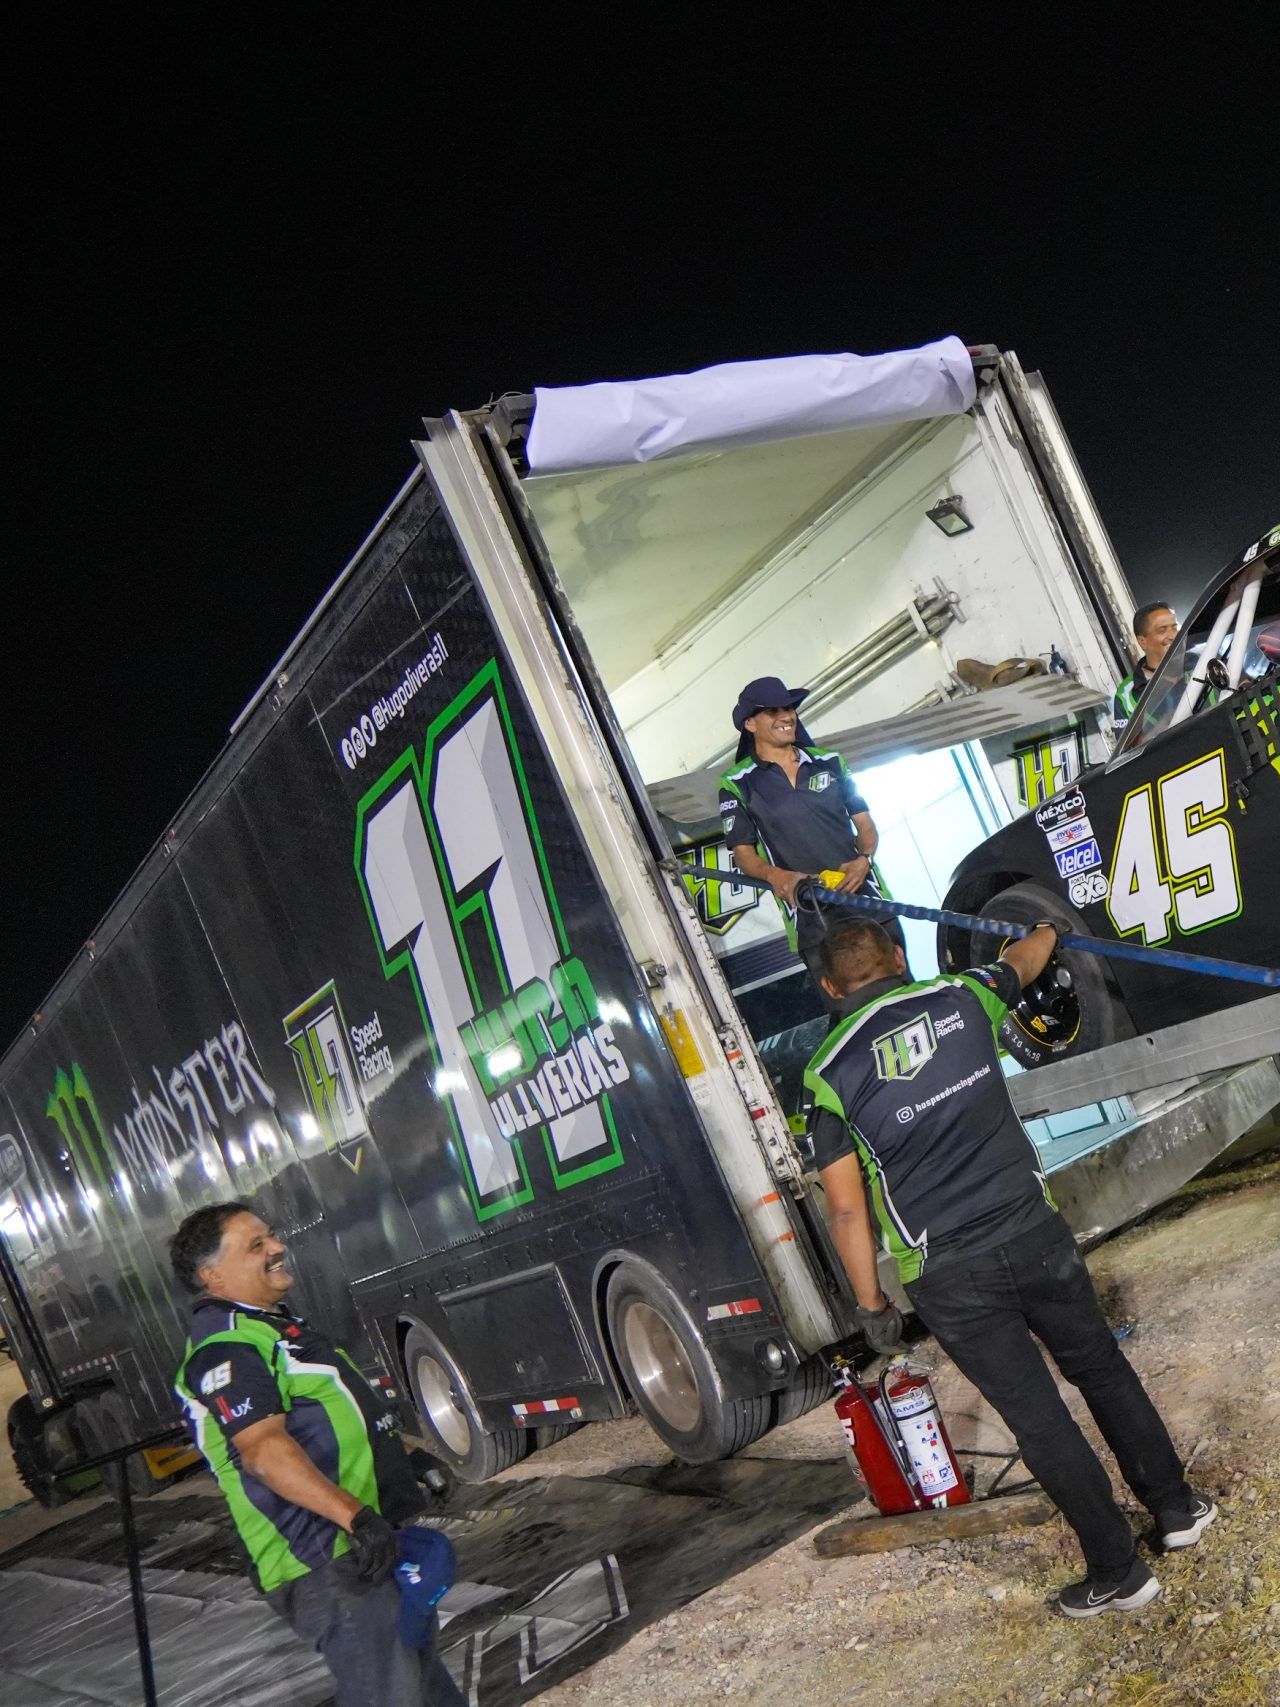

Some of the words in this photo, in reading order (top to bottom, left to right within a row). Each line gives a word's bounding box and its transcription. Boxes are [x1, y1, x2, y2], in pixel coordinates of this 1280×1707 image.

[1037, 797, 1082, 823] MÉXICO
[1061, 841, 1095, 875] telcel
[1106, 748, 1242, 947] 45
[1071, 876, 1108, 904] exa
[356, 660, 622, 1215] 11
[351, 1011, 382, 1053] Speed
[934, 1011, 961, 1031] Speed
[936, 1019, 965, 1040] Racing
[357, 1044, 394, 1082] Racing
[490, 1024, 631, 1138] OLIVERAS
[201, 1361, 232, 1394] 45
